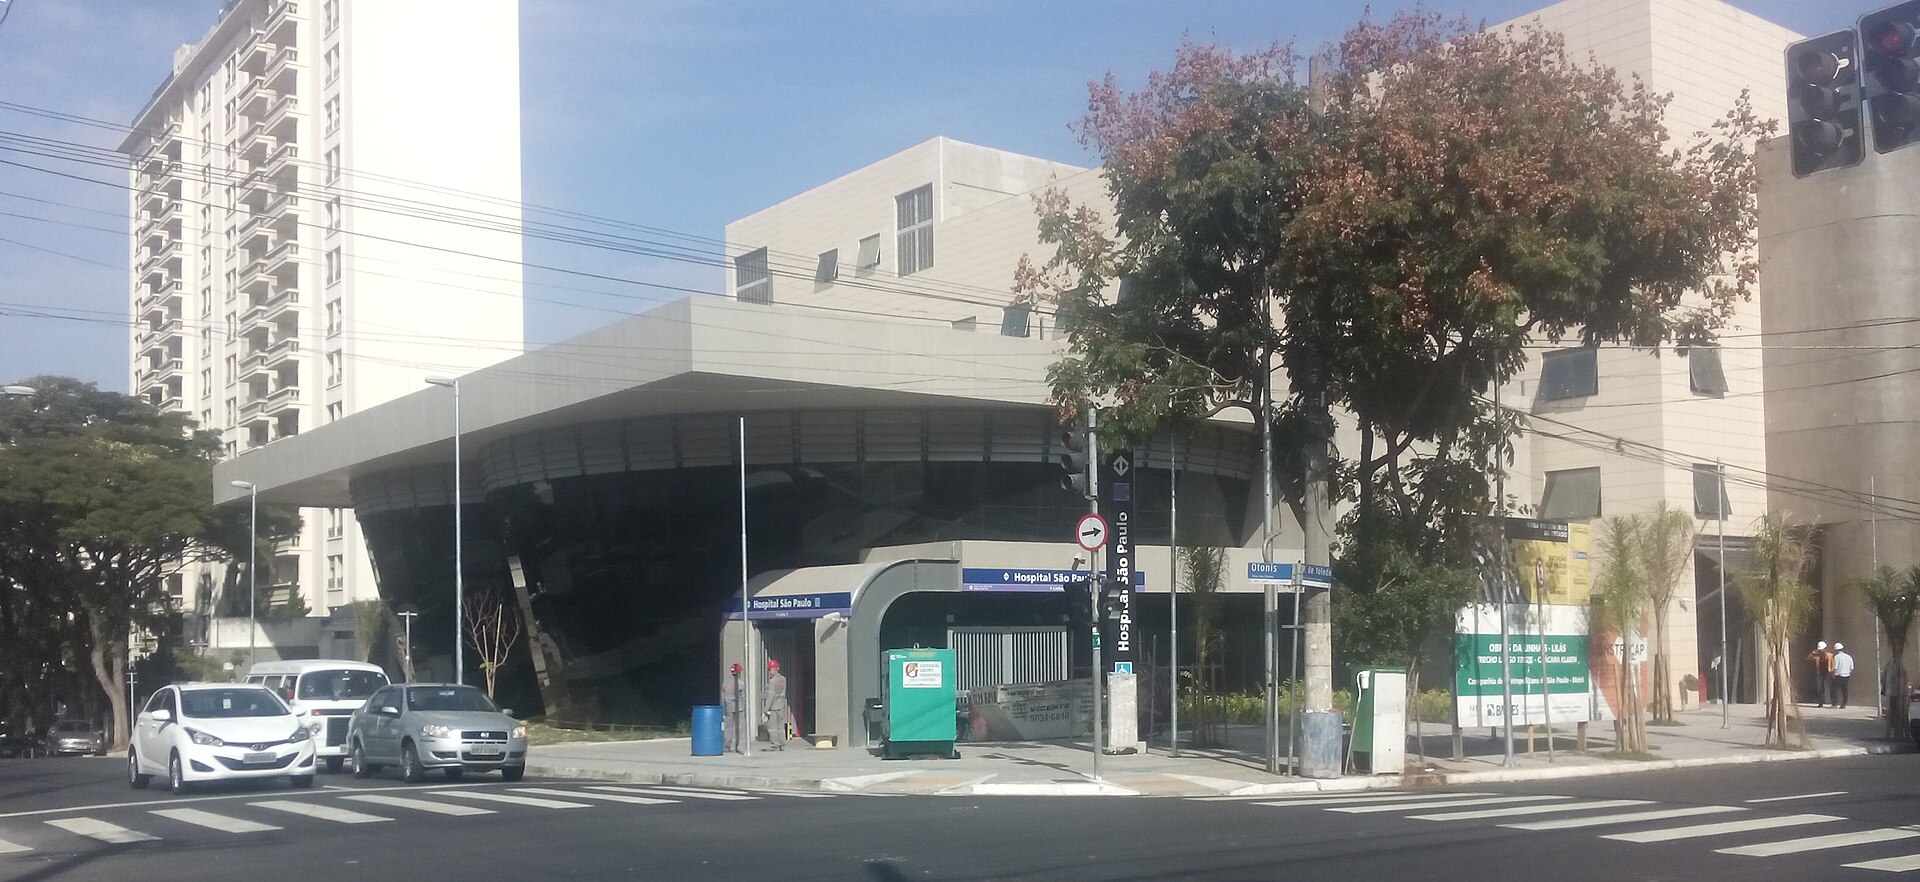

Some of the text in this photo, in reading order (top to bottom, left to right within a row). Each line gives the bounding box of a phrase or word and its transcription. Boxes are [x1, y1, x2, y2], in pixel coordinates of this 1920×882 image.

[1116, 511, 1128, 554] Paulo
[1251, 563, 1278, 573] Otonis
[1014, 572, 1051, 584] Hospital
[1053, 572, 1070, 583] São
[753, 598, 812, 610] Hospital São Paulo
